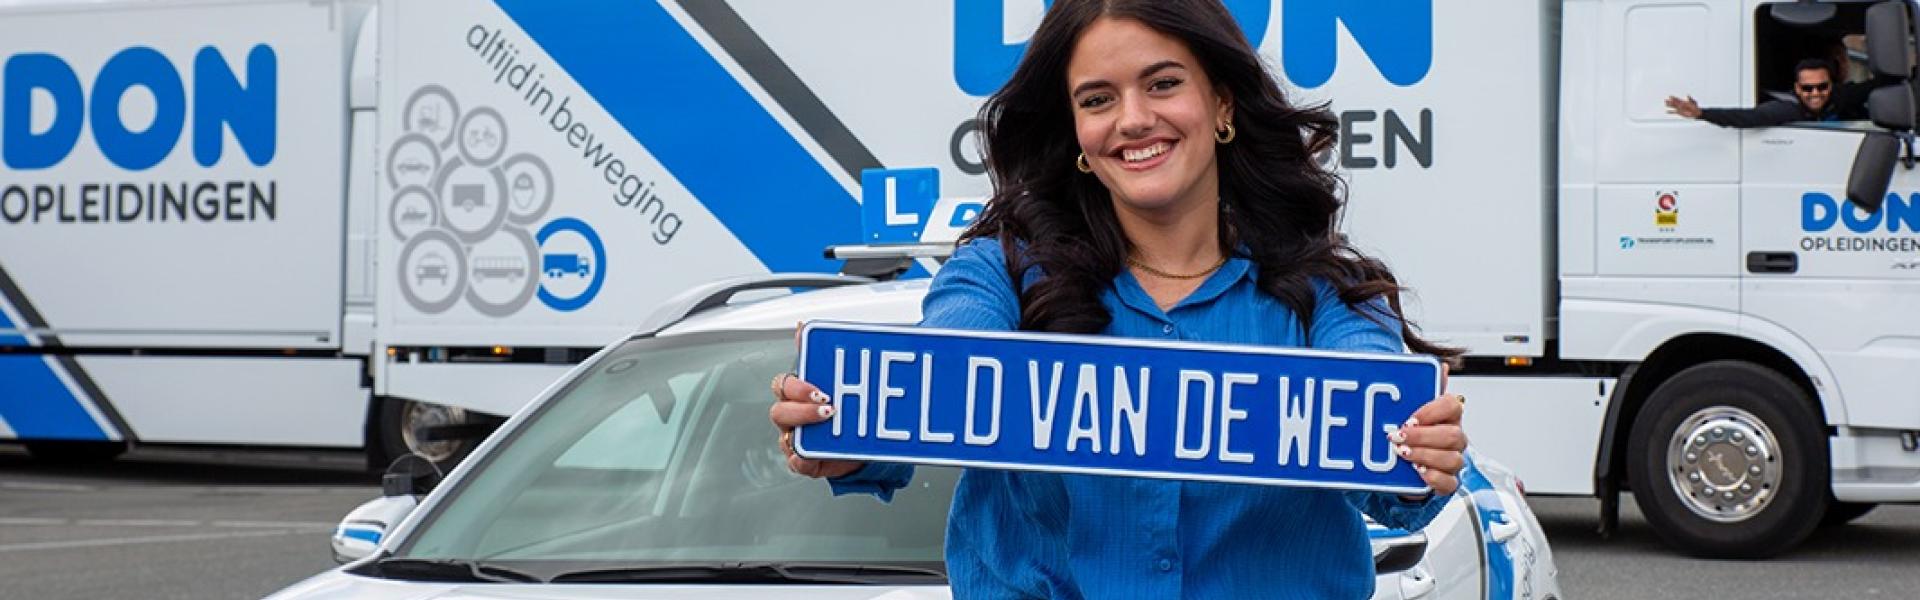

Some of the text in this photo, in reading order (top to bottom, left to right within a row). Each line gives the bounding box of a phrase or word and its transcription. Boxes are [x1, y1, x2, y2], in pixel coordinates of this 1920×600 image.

[2, 43, 277, 171] DON
[466, 24, 683, 245] altijd in beweging
[0, 180, 277, 224] OPLEIDINGEN
[885, 176, 919, 226] L
[1802, 192, 1920, 233] DON
[832, 347, 1401, 472] HELD VAN DE WEG
